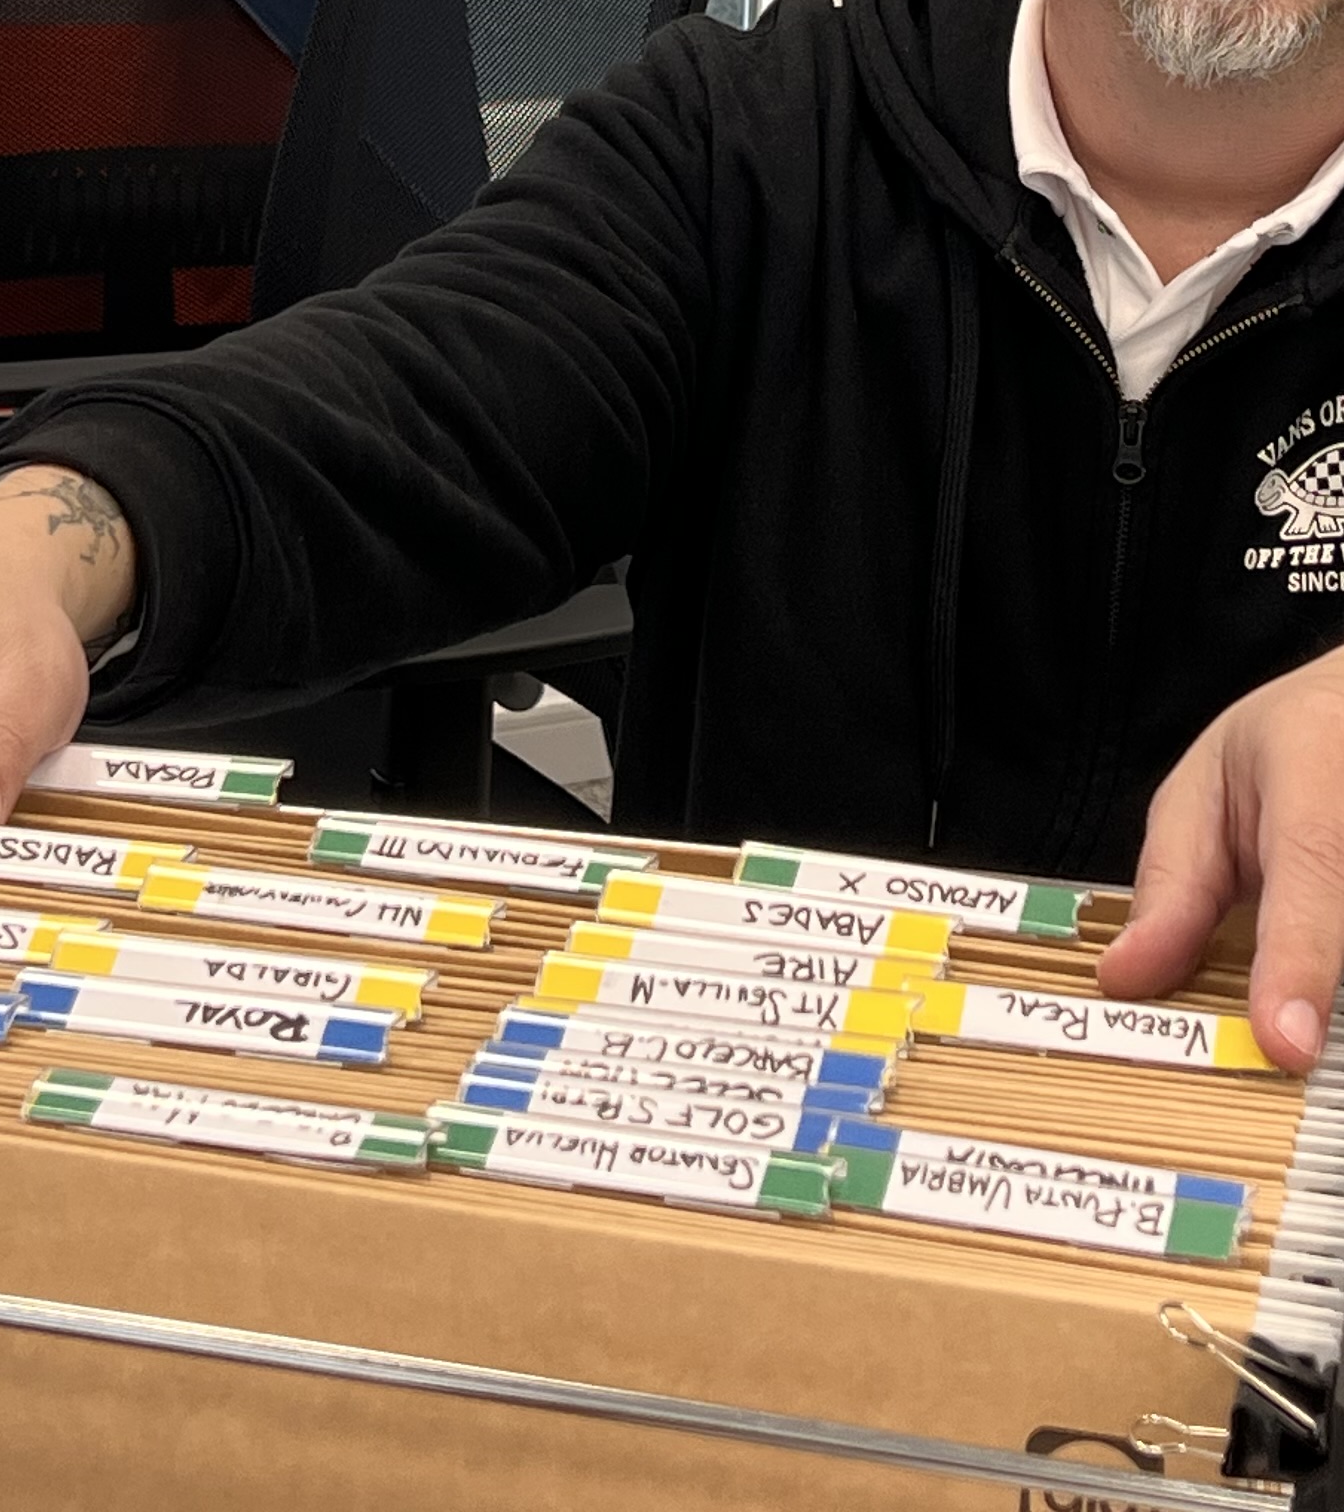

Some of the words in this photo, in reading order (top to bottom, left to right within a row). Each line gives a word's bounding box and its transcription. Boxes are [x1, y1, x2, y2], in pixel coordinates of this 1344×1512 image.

[1257, 409, 1315, 468] VANS
[1244, 547, 1286, 571] OFF
[1288, 544, 1334, 567] THE
[105, 758, 216, 788] POSADA
[838, 871, 870, 895] X
[886, 877, 1019, 915] ALFONSO
[743, 900, 886, 945] ABADES
[204, 959, 351, 1002] GIRALDA
[754, 953, 858, 985] AIRE
[174, 1000, 309, 1043] ROYAL
[997, 992, 1090, 1040] REAL
[1102, 1011, 1209, 1057] VEREDA
[677, 1038, 817, 1082] BARCELO
[664, 1105, 785, 1141] GOLF
[504, 1129, 621, 1174] HUELVA
[629, 1148, 759, 1191] SENATOR
[902, 1159, 1017, 1212] UMBRIA
